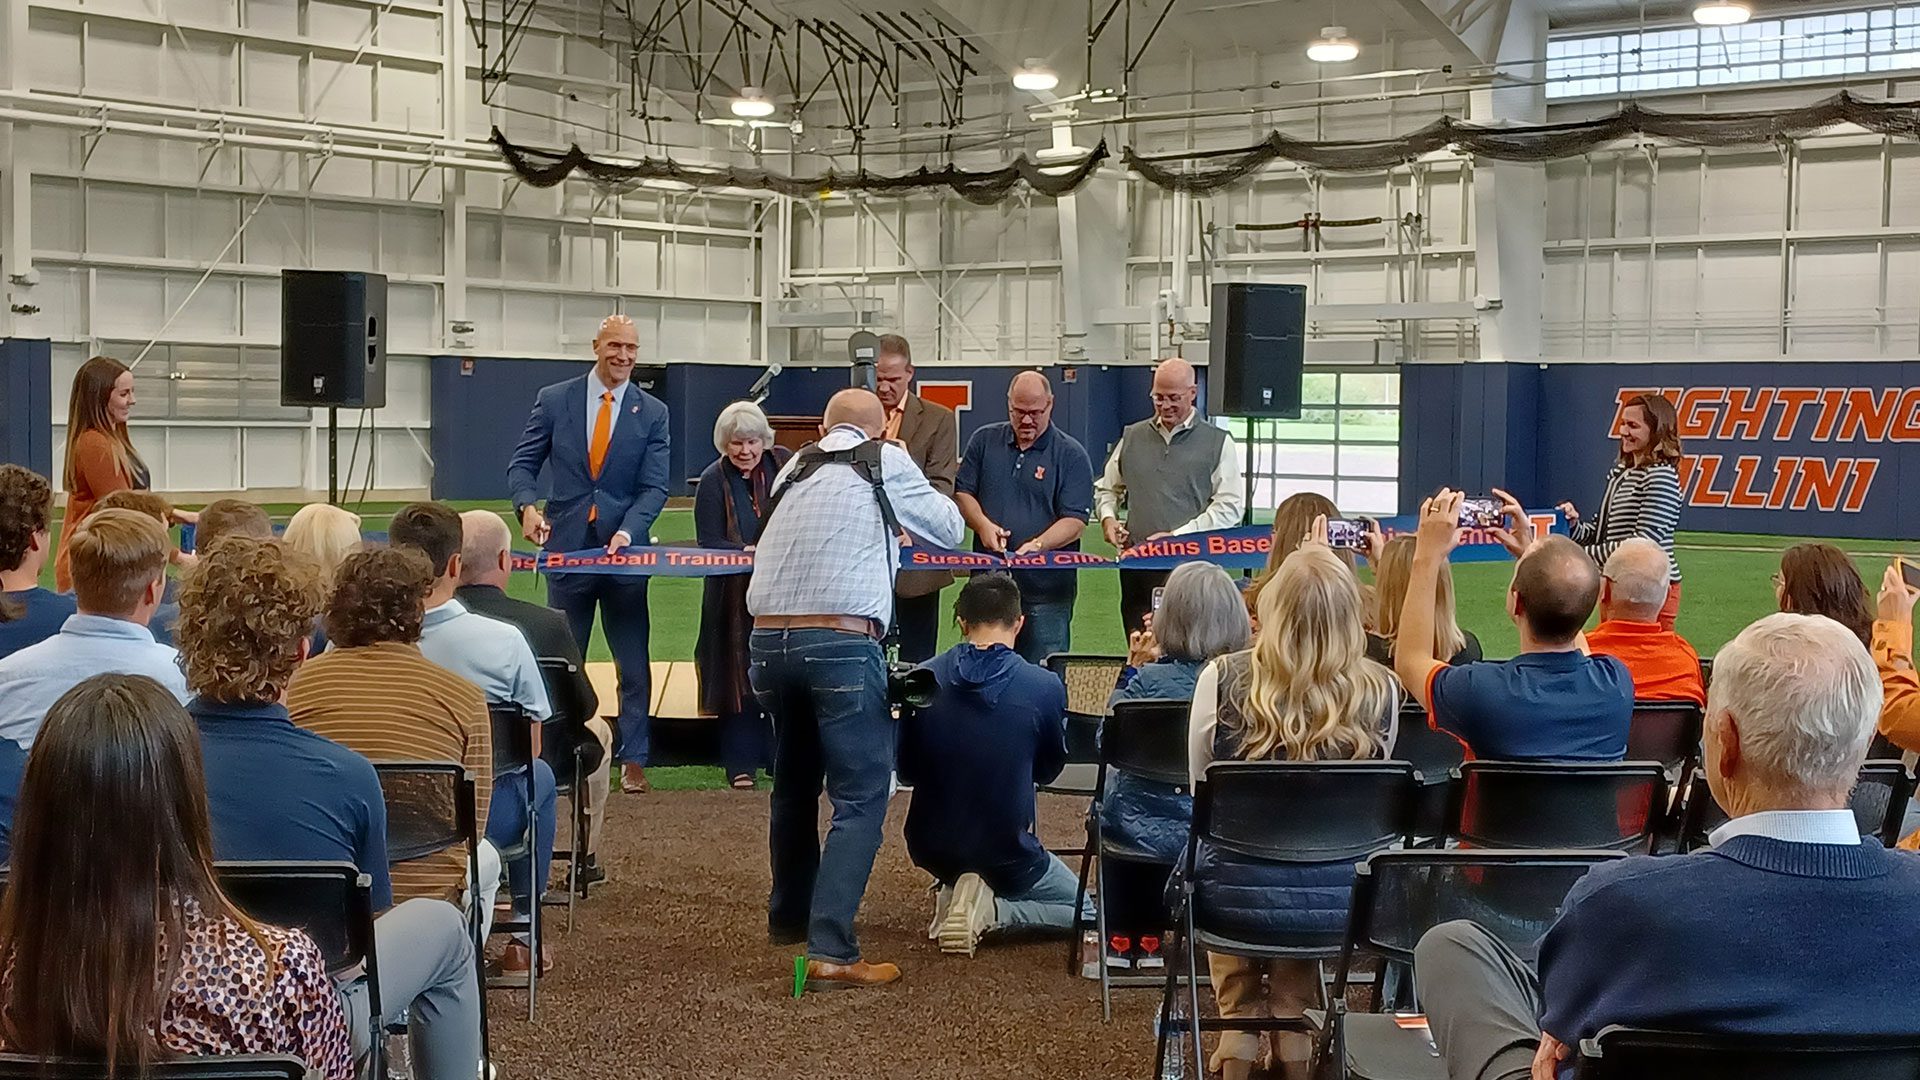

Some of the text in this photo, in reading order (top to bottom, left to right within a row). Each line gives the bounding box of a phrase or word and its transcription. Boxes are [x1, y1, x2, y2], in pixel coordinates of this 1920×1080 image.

[665, 553, 753, 566] Trainin
[912, 552, 992, 566] Susan
[1054, 554, 1106, 565] Clin
[1120, 541, 1200, 559] Atkins
[1208, 536, 1275, 554] Base
